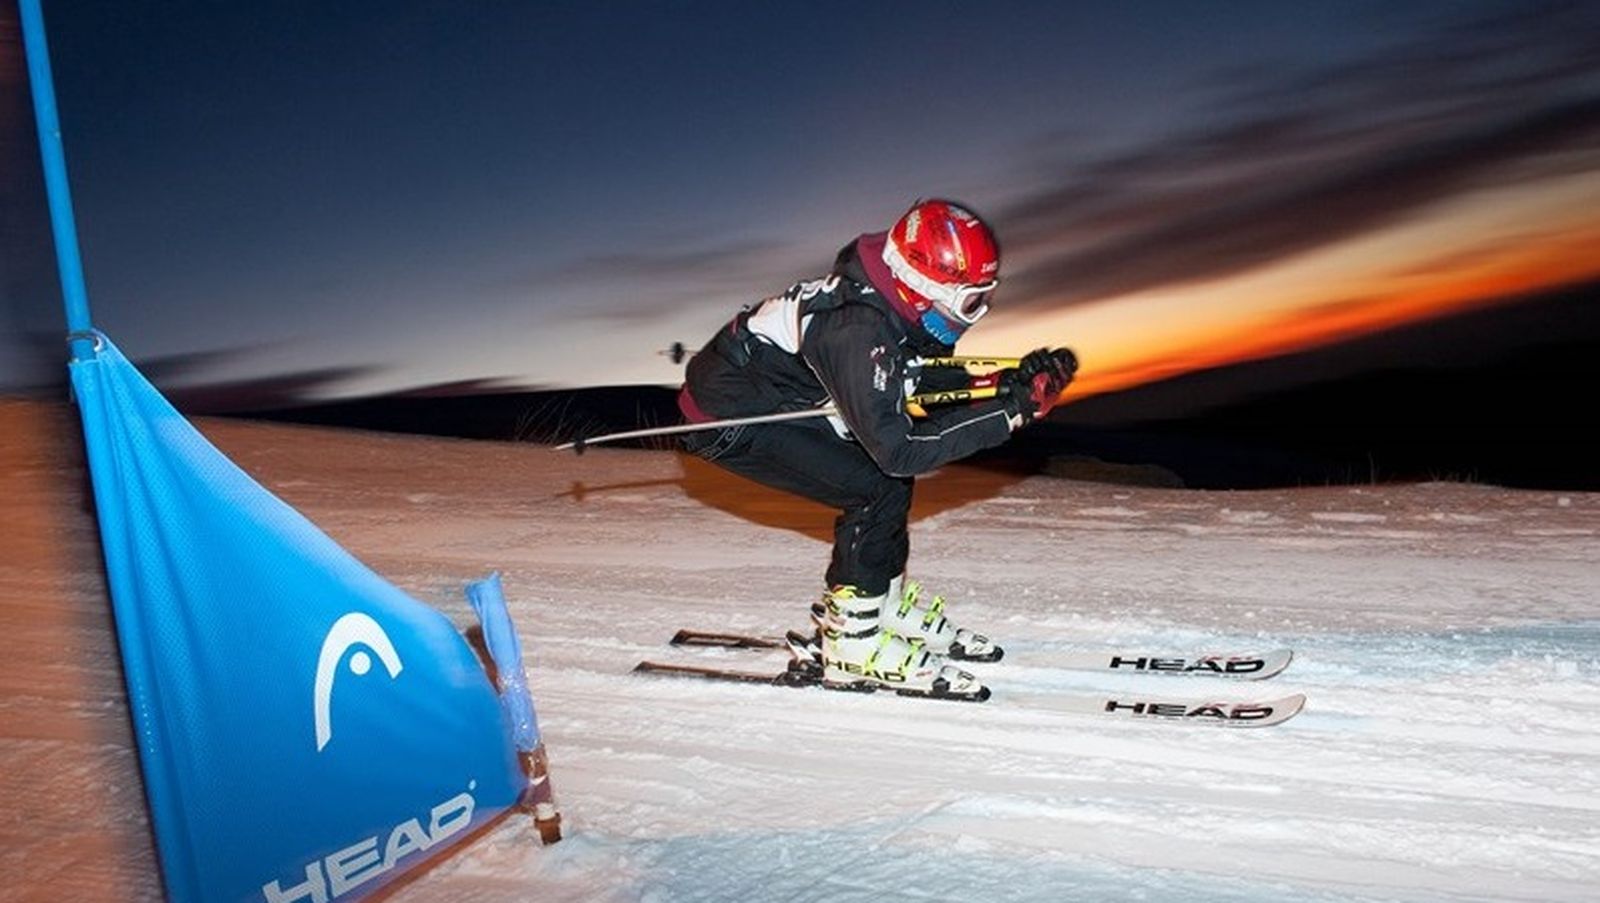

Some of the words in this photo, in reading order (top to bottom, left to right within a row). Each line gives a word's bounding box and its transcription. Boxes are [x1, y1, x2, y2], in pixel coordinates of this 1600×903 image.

[825, 657, 906, 683] HEAD
[1109, 656, 1265, 674] HEAD
[1105, 700, 1274, 720] HEAD
[262, 792, 476, 903] HEAD
